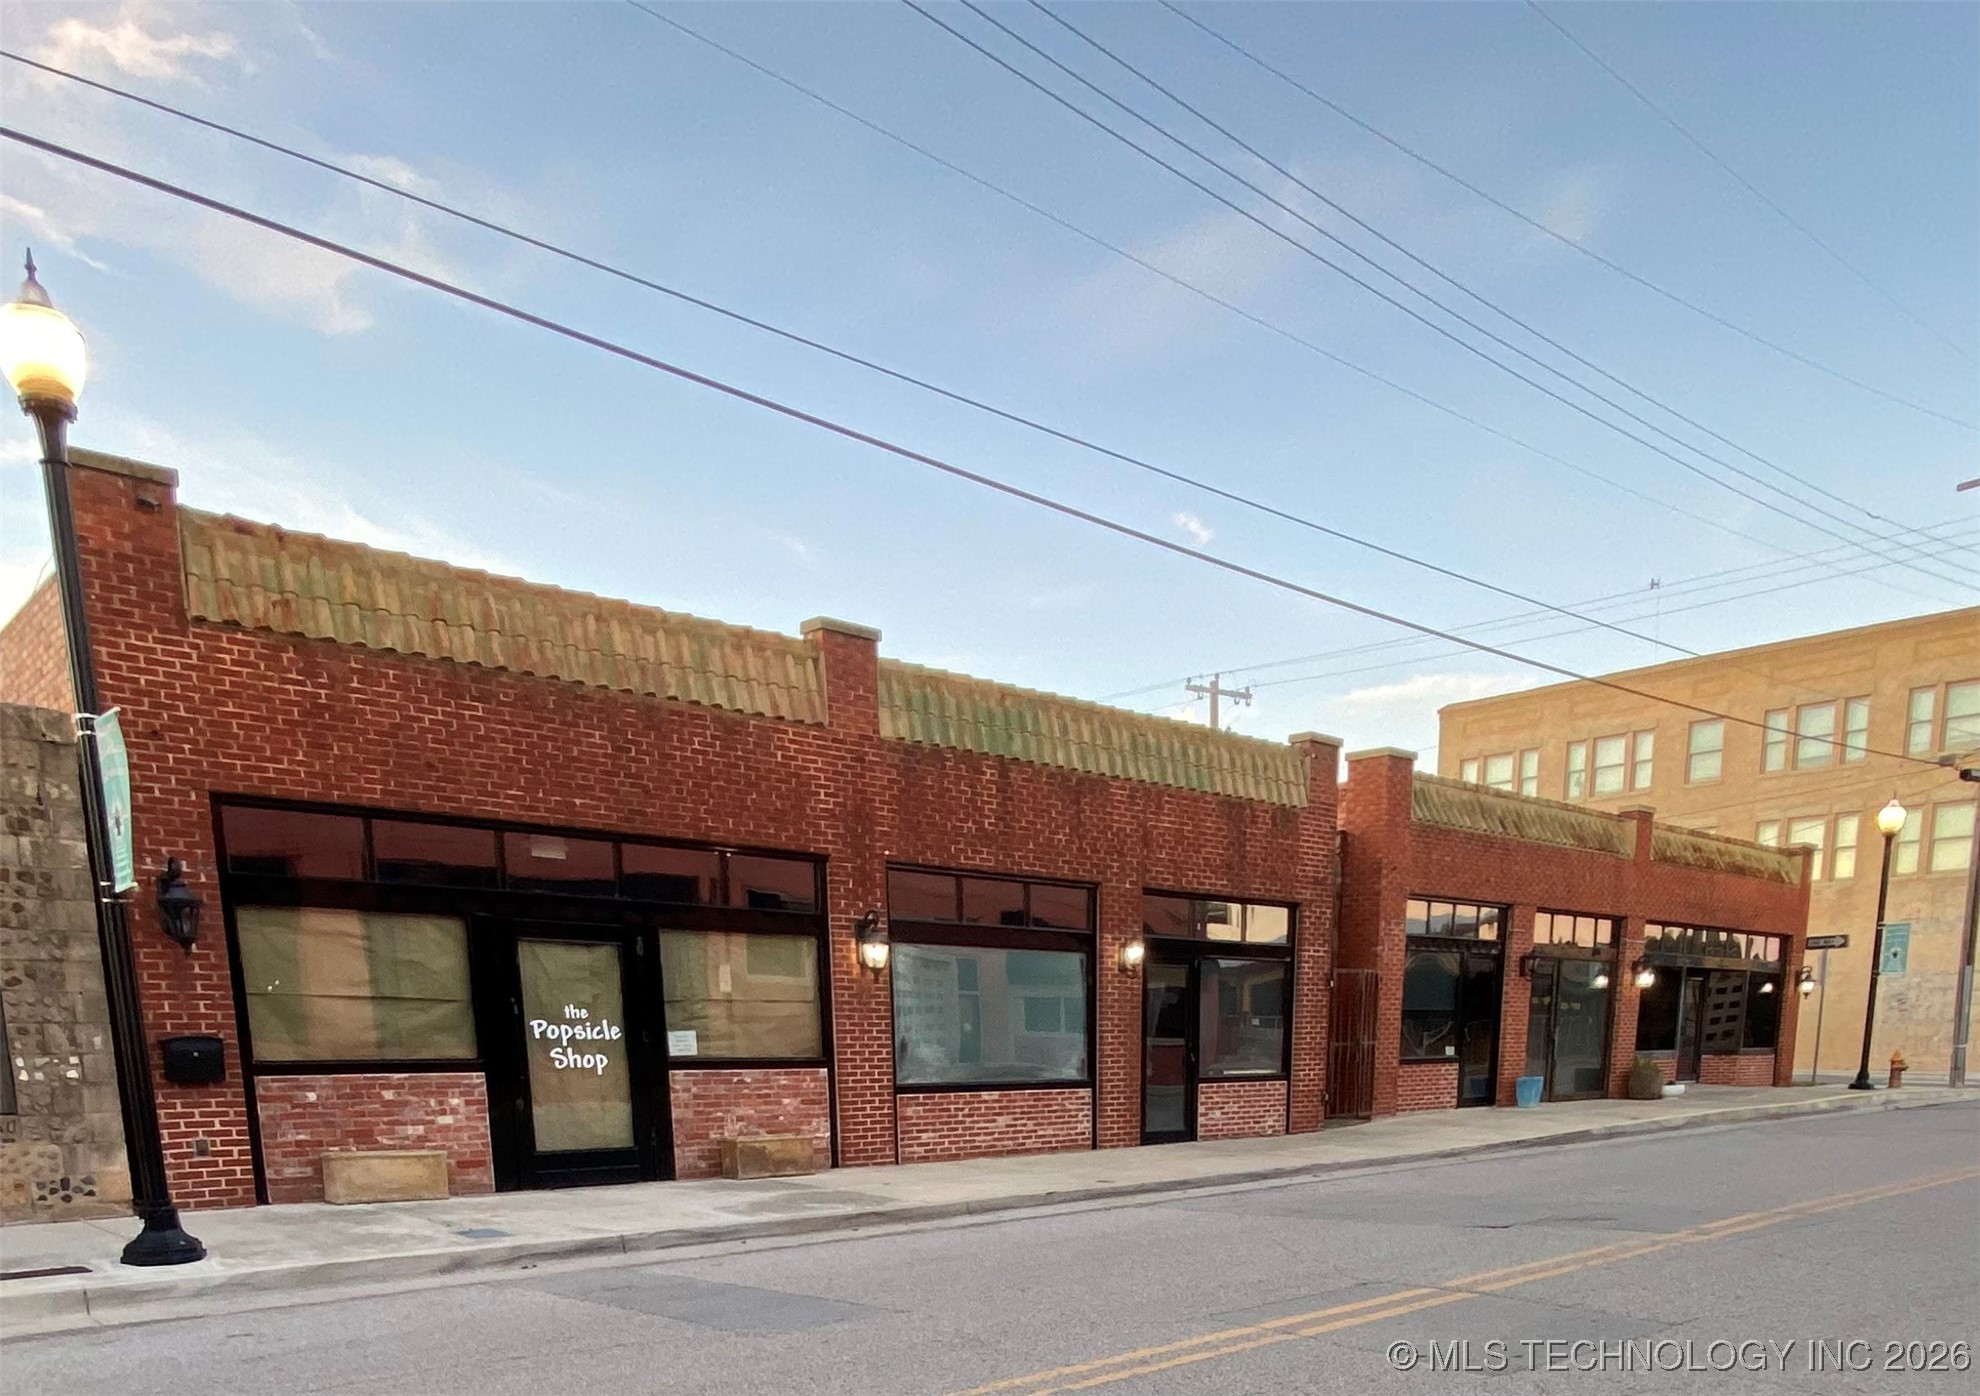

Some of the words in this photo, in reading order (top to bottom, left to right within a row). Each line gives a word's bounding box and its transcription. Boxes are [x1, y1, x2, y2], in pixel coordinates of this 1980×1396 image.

[564, 1003, 589, 1019] the
[529, 1019, 622, 1046] Popsicle
[549, 1047, 608, 1075] Shop
